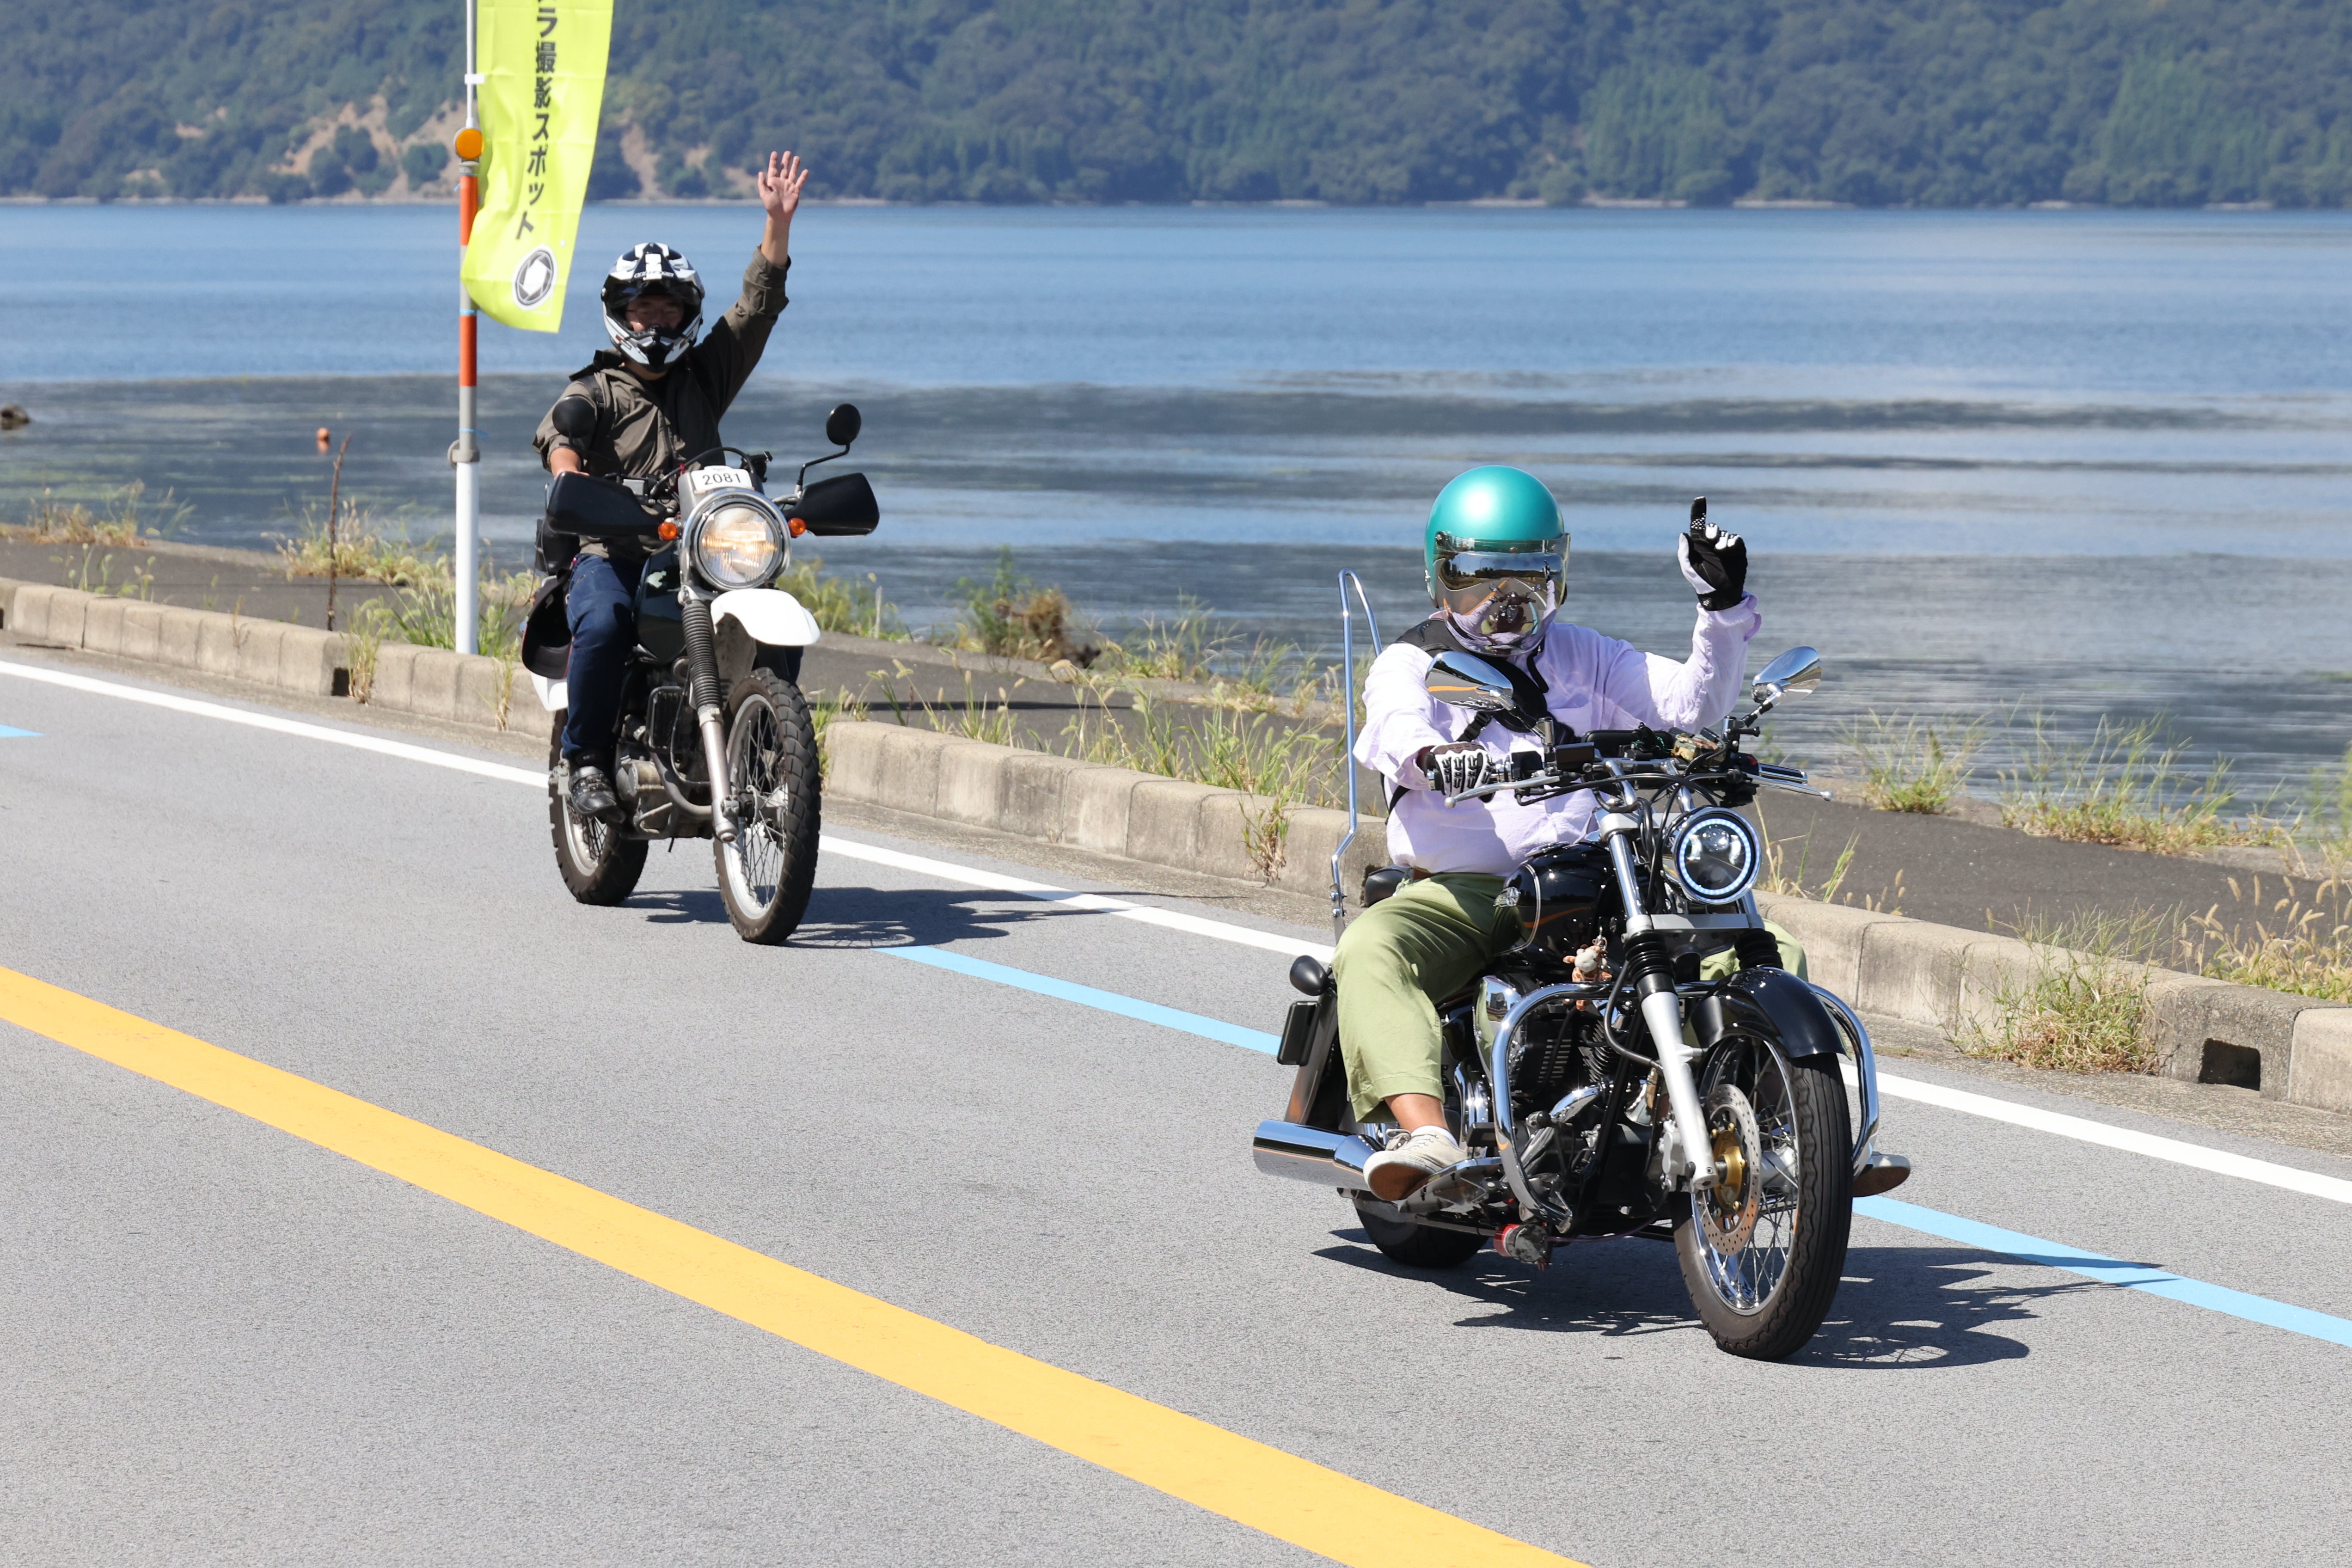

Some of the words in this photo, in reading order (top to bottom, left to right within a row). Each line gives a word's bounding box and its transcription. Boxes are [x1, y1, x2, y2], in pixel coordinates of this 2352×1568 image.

[516, 0, 558, 240] ラ撮影スポット
[702, 472, 741, 485] 2081
